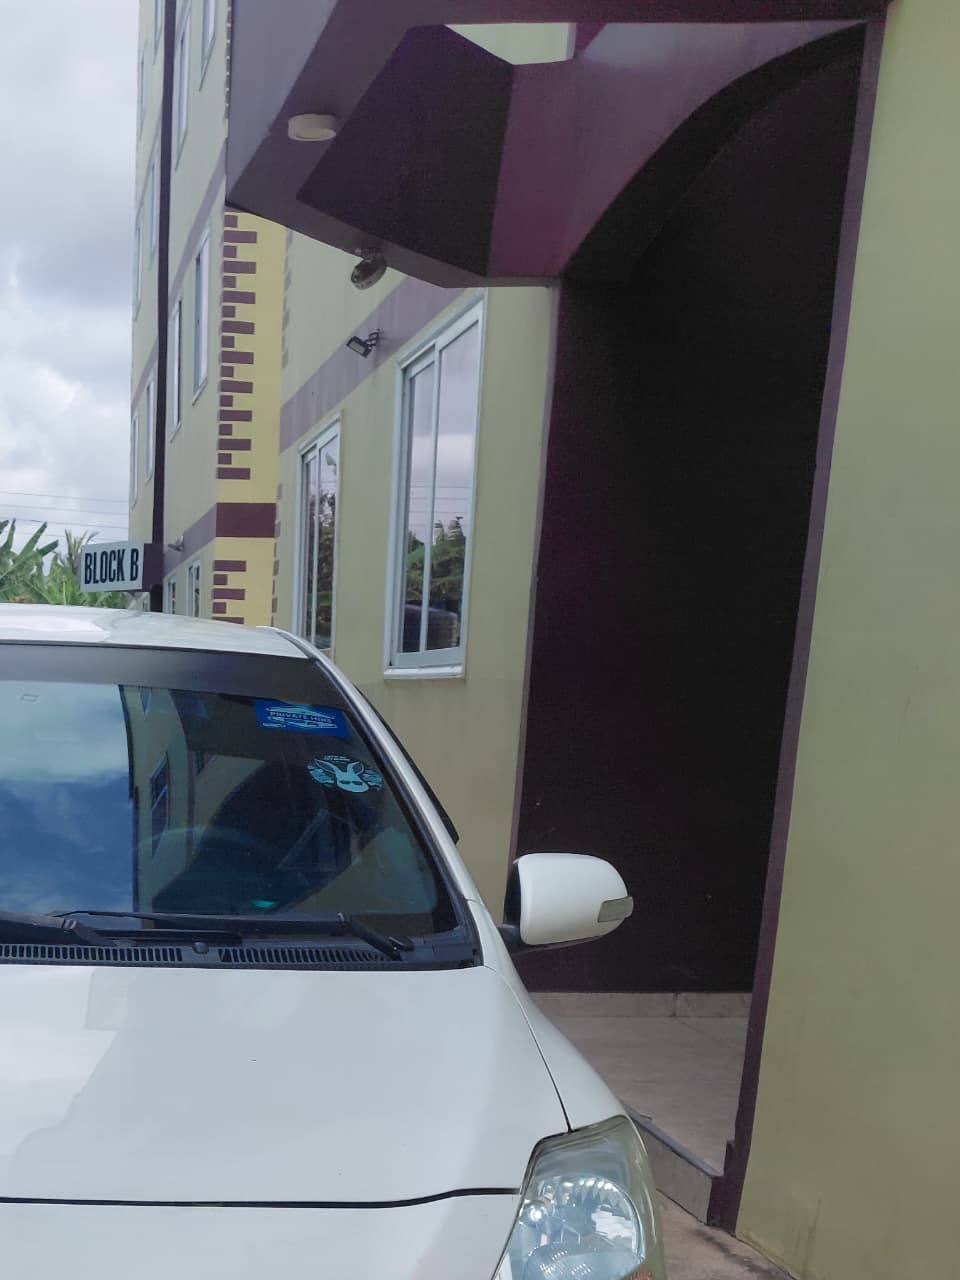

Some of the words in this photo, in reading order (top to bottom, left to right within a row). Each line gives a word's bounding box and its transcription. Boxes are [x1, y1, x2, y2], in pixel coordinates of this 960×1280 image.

[84, 549, 126, 585] BLOCK
[130, 548, 139, 582] B
[269, 711, 308, 722] PRIVATE
